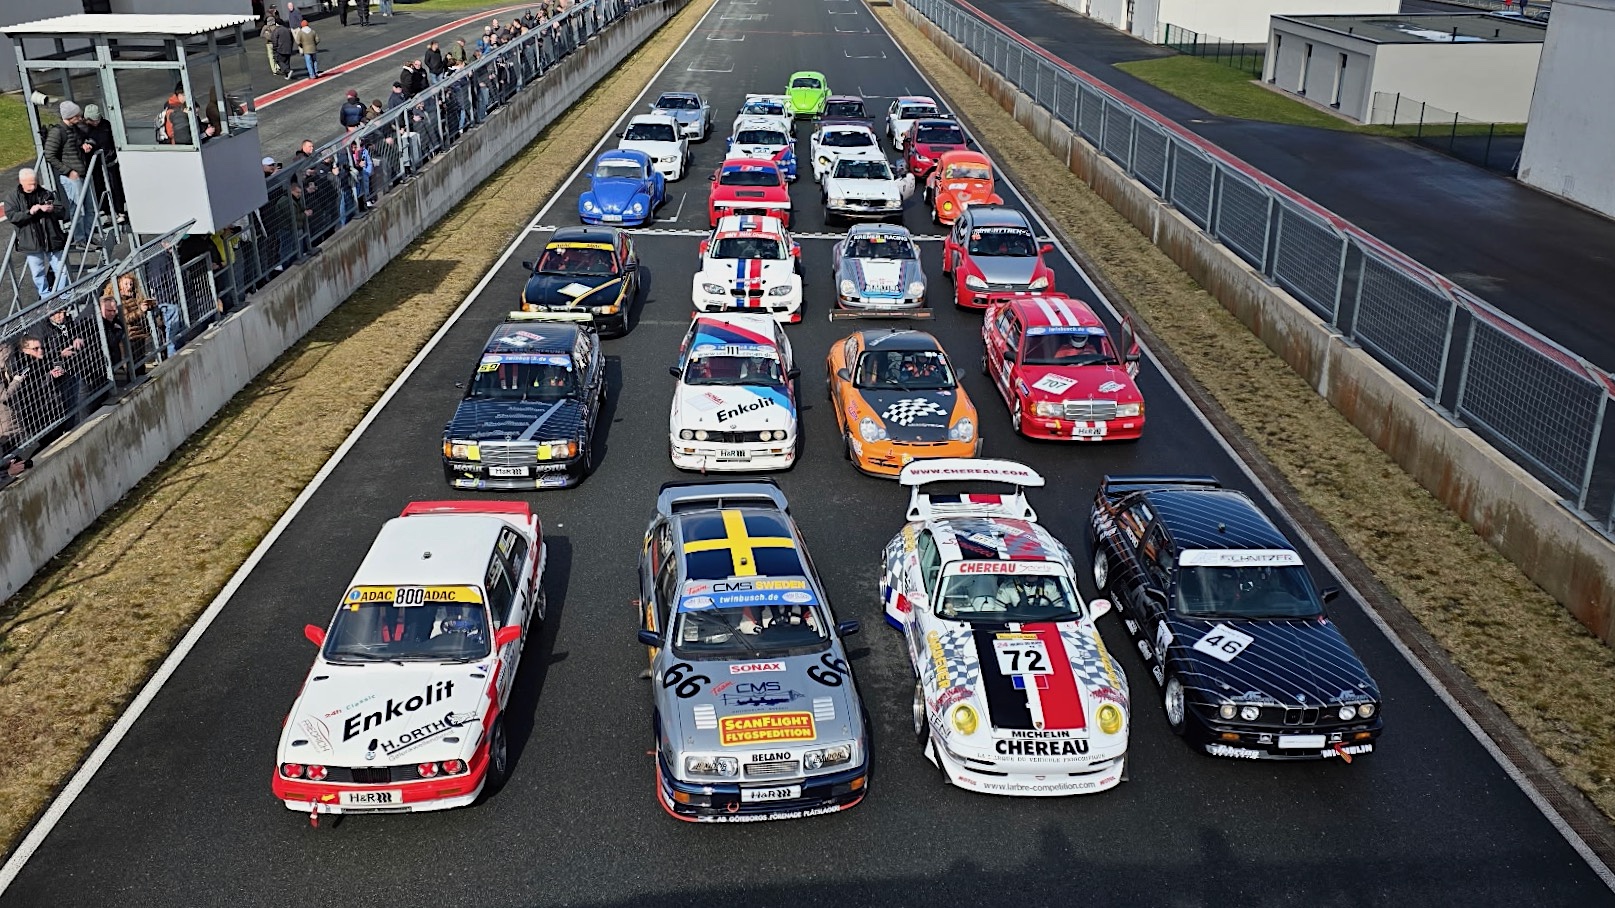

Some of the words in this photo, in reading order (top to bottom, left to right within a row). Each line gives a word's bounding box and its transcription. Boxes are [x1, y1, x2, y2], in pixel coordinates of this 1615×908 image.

[727, 346, 739, 355] 111
[1042, 379, 1067, 389] 707
[717, 397, 776, 423] Enkolit
[910, 468, 1029, 477] WWW.CHEREAU.COM
[960, 563, 1016, 573] CHEREAU
[713, 582, 752, 592] CMS
[755, 580, 806, 590] SWEDEN
[361, 591, 393, 601] ADAC
[396, 588, 424, 604] 800
[424, 591, 456, 601] ADAC
[719, 594, 779, 604] twinbusch.de
[1206, 636, 1242, 654] 46
[1003, 650, 1047, 671] 72
[731, 663, 781, 673] SONAX
[807, 652, 850, 687] 66
[662, 662, 711, 699] 66
[736, 681, 781, 693] CMS
[342, 680, 455, 742] Enkolit
[726, 729, 811, 742] FLYGSPEDITION
[1012, 730, 1070, 739] MICHELIN
[996, 739, 1089, 756] CHEREAU
[752, 752, 791, 762] BELANO
[983, 781, 1095, 792] www.larbre-competition.com
[350, 792, 375, 803] H&R
[729, 813, 768, 823] GÖTEBORGS
